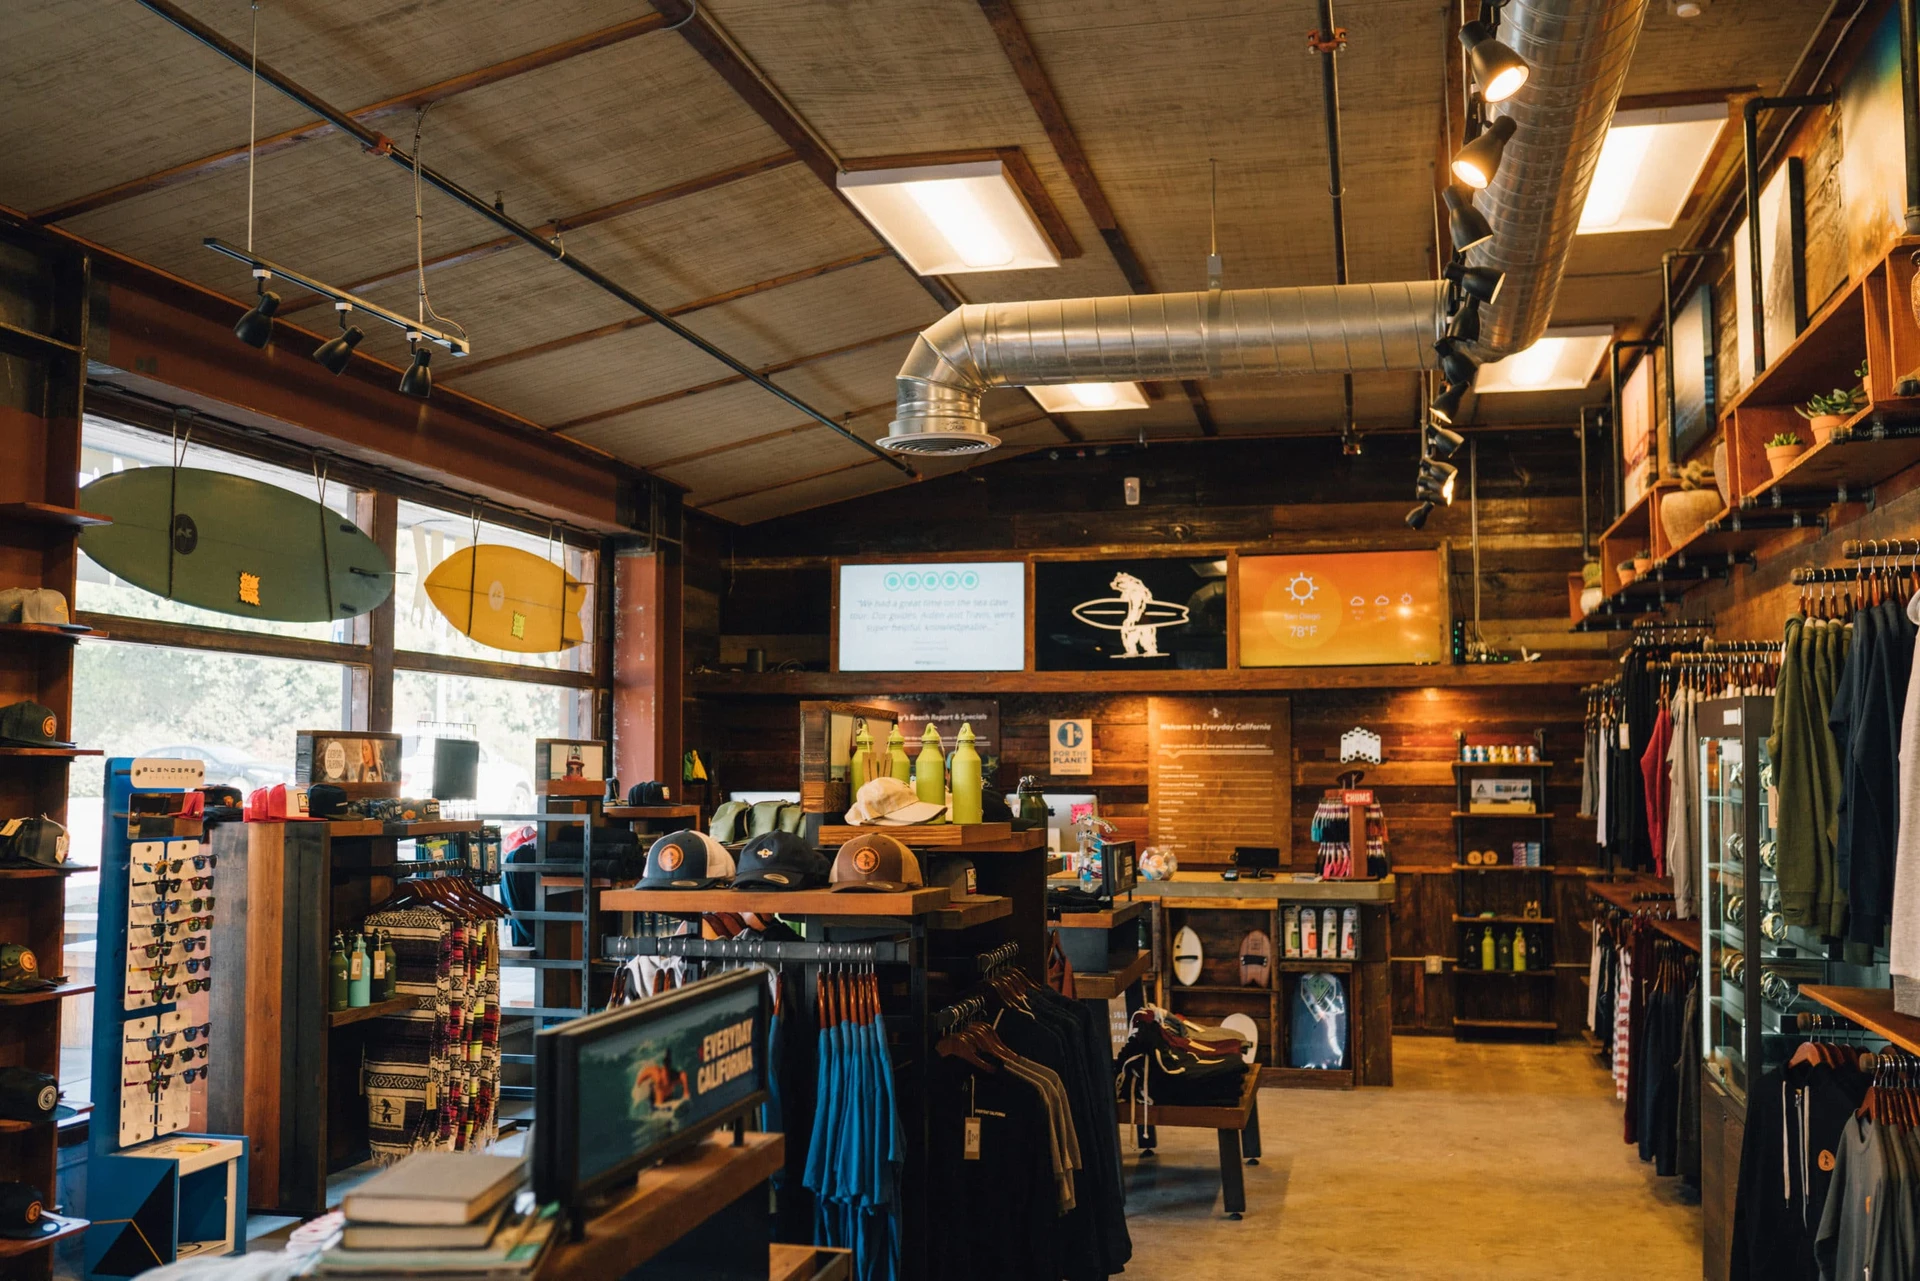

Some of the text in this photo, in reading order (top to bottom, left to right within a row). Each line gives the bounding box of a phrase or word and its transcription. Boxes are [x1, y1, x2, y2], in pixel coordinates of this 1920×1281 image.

[910, 713, 930, 721] Beach
[931, 713, 953, 722] Report
[961, 713, 987, 722] Specials
[1160, 723, 1271, 732] Welcome to Everyday California
[143, 766, 196, 774] BLENDERS
[1345, 792, 1371, 803] CHUMS
[703, 1017, 754, 1062] EVERYDAY
[697, 1045, 754, 1096] CALIFORNIA
